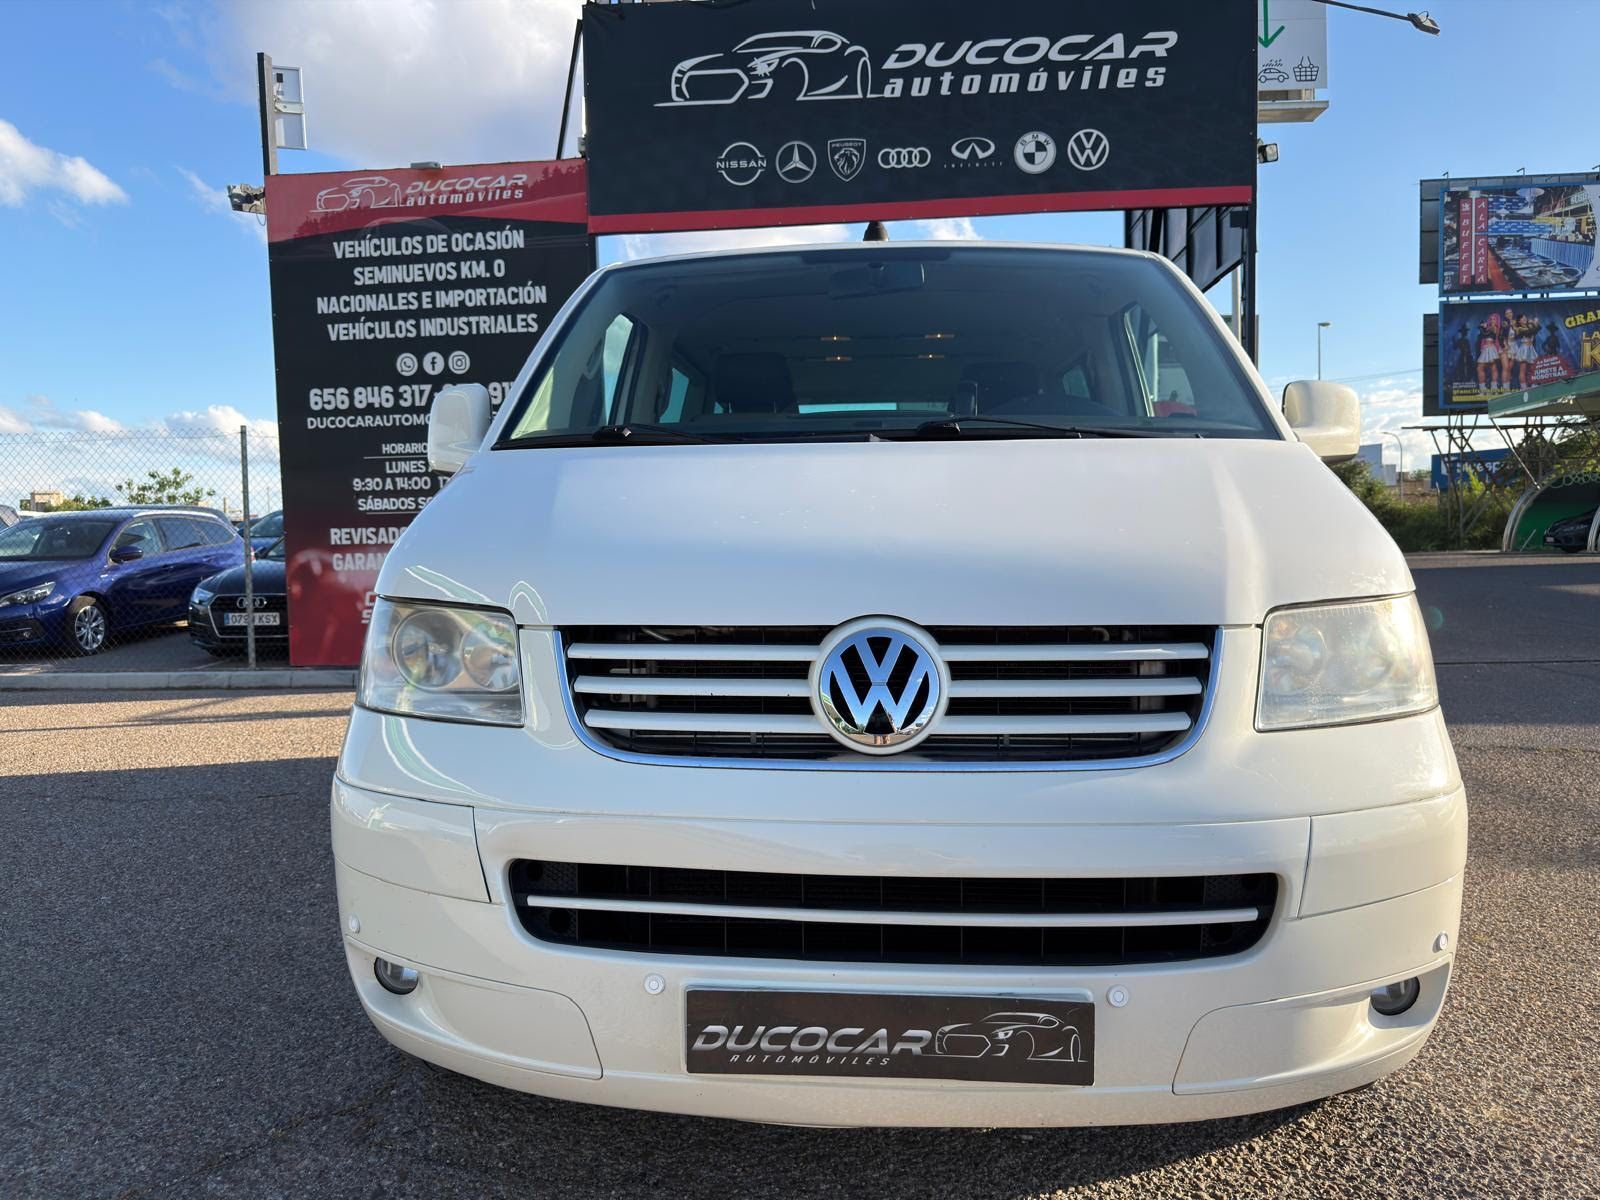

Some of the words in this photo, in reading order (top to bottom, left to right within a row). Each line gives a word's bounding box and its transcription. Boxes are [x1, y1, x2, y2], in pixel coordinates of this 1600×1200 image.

[881, 31, 1178, 69] DUCOCAR
[883, 66, 1166, 98] automóviles
[716, 159, 767, 169] NISSAN
[406, 174, 527, 194] DUCOCAR
[333, 234, 423, 259] VEHÍCULOS
[426, 233, 448, 253] DE
[451, 226, 525, 252] OCASIÓN
[353, 262, 457, 285] SEMINUEVOS
[460, 261, 491, 279] KM.
[316, 292, 418, 314] NACIONALES
[421, 291, 433, 309] E
[435, 282, 547, 308] IMPORTACIÓN
[327, 317, 417, 341] VEHÍCULOS
[420, 313, 539, 336] INDUSTRIALES
[309, 387, 350, 411] 656
[353, 385, 394, 409] 846
[399, 384, 433, 407] 317
[385, 460, 426, 474] LUNES
[352, 477, 383, 491] 9:30
[384, 477, 394, 491] A
[395, 476, 431, 491] 14:00
[358, 495, 417, 511] SÁBADOS
[259, 613, 278, 624] KSX
[691, 1025, 933, 1055] DUCOCAR
[729, 1054, 890, 1066] AUTOMÓVILES
